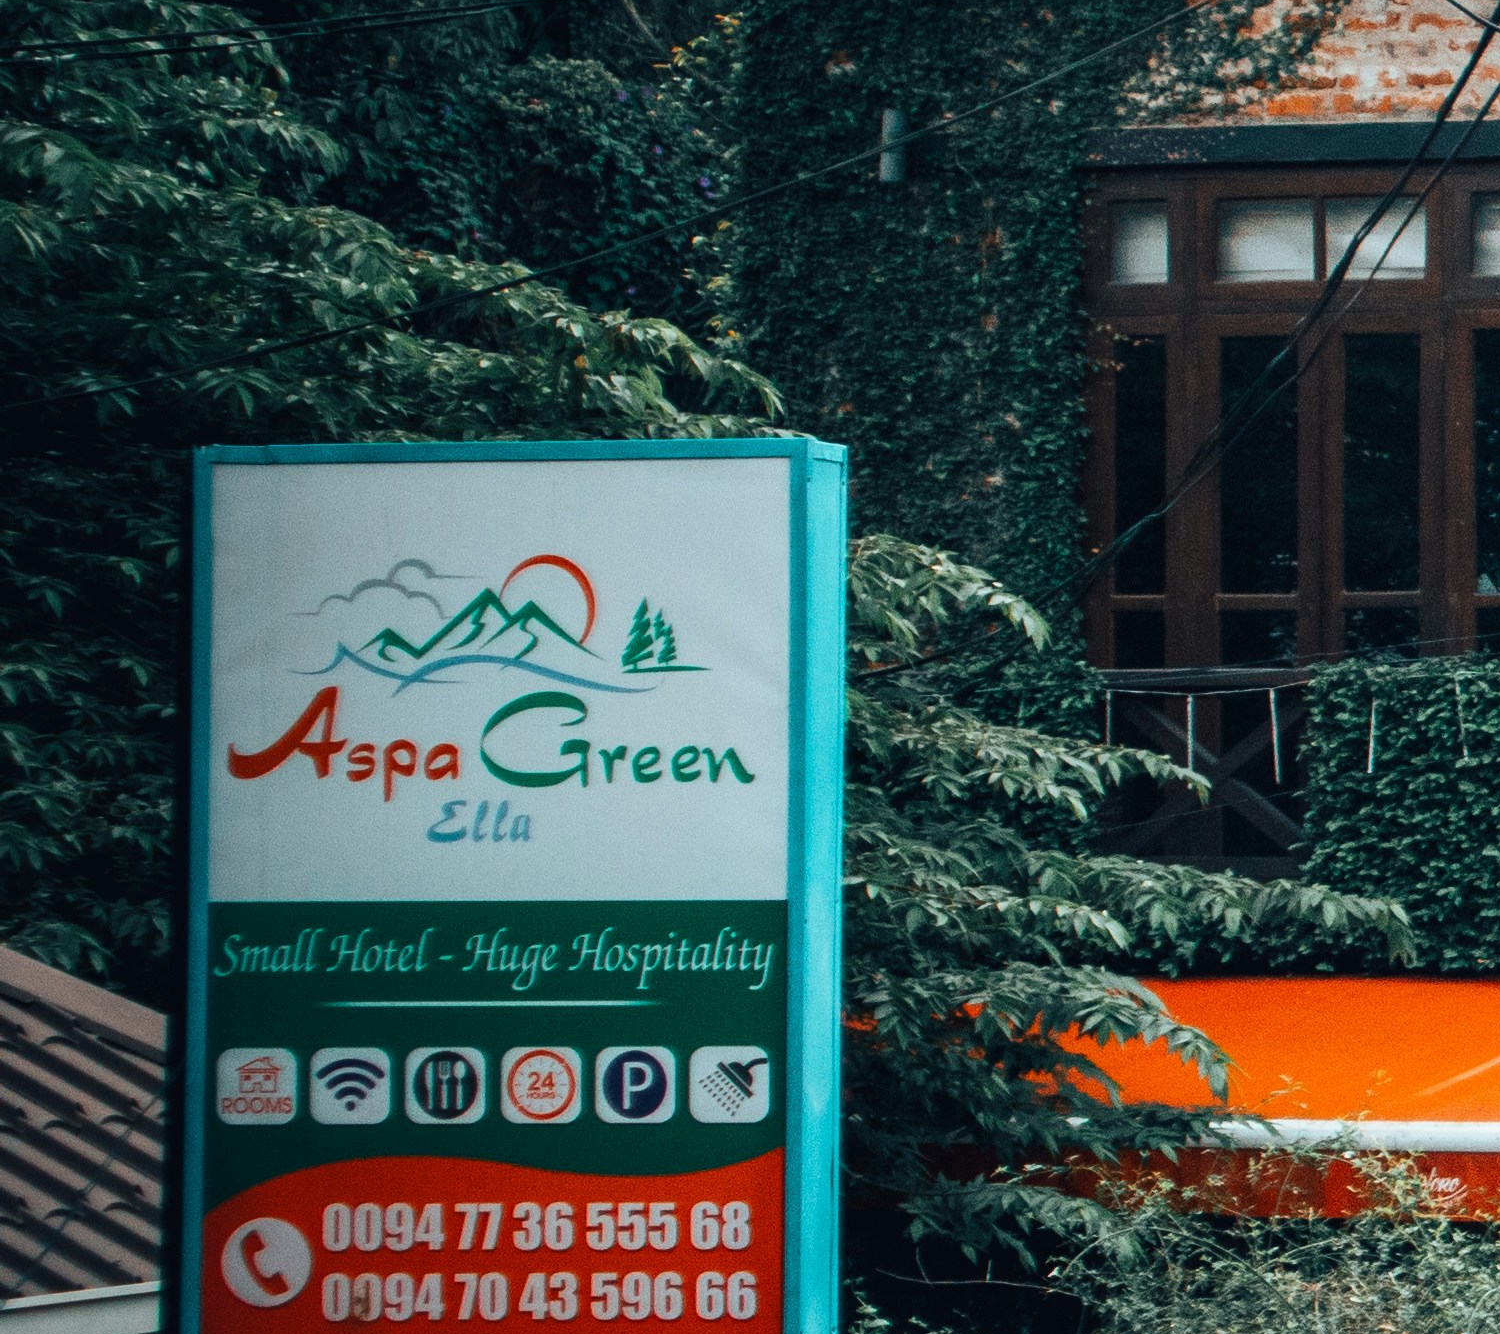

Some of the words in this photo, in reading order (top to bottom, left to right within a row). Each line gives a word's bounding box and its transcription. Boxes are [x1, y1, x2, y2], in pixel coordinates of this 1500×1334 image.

[227, 685, 461, 803] Aspa
[480, 690, 756, 790] Green
[426, 799, 534, 845] Ella
[212, 926, 319, 977] Small
[326, 928, 429, 973] Hotel
[462, 929, 559, 991] Huge
[570, 926, 775, 991] Hospitality
[220, 1096, 293, 1115] ROOMS
[527, 1072, 556, 1092] 24
[322, 1201, 445, 1252] 0094
[453, 1201, 501, 1252] 77
[515, 1201, 574, 1251] 36
[584, 1202, 680, 1251] 555
[689, 1201, 752, 1250] 68
[322, 1271, 445, 1323] 0094
[456, 1271, 508, 1322] 70
[518, 1271, 579, 1322] 43
[590, 1270, 683, 1322] 596
[695, 1270, 757, 1322] 66
